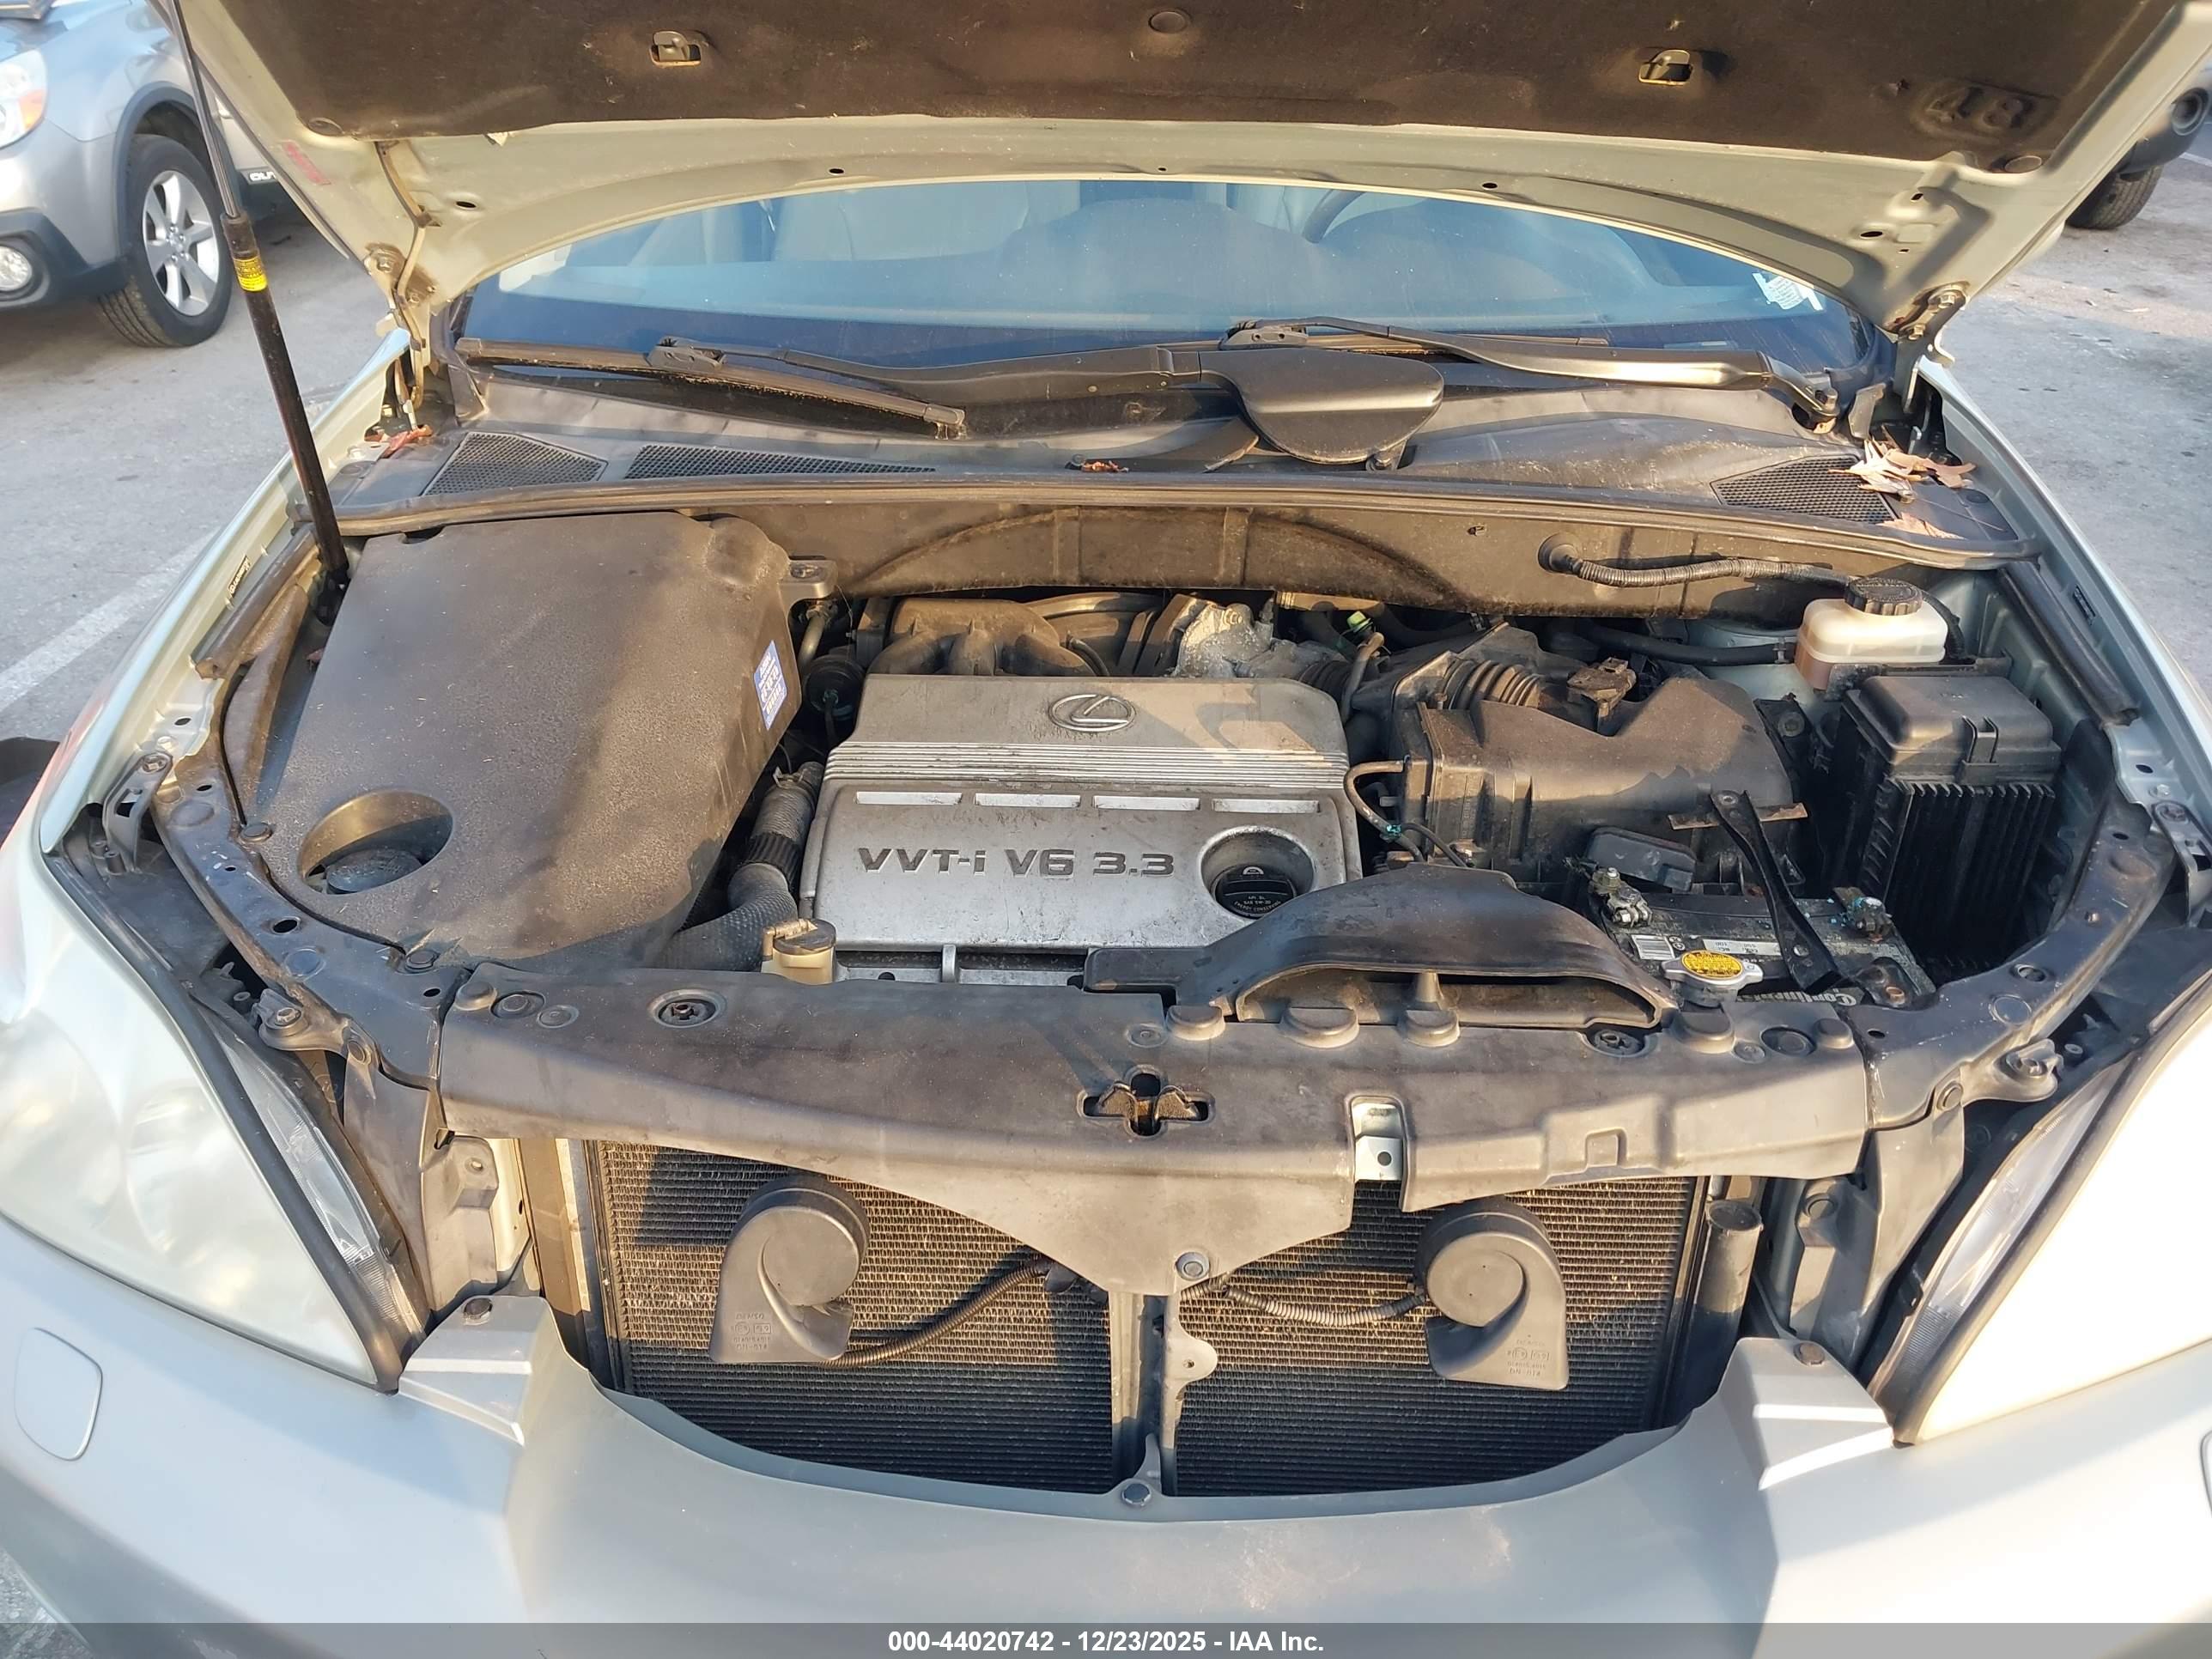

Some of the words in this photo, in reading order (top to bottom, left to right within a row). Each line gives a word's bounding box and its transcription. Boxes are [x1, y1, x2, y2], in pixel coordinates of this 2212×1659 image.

[858, 847, 987, 875] VVT-i
[1004, 848, 1075, 878] V6
[1093, 851, 1175, 878] 3.3
